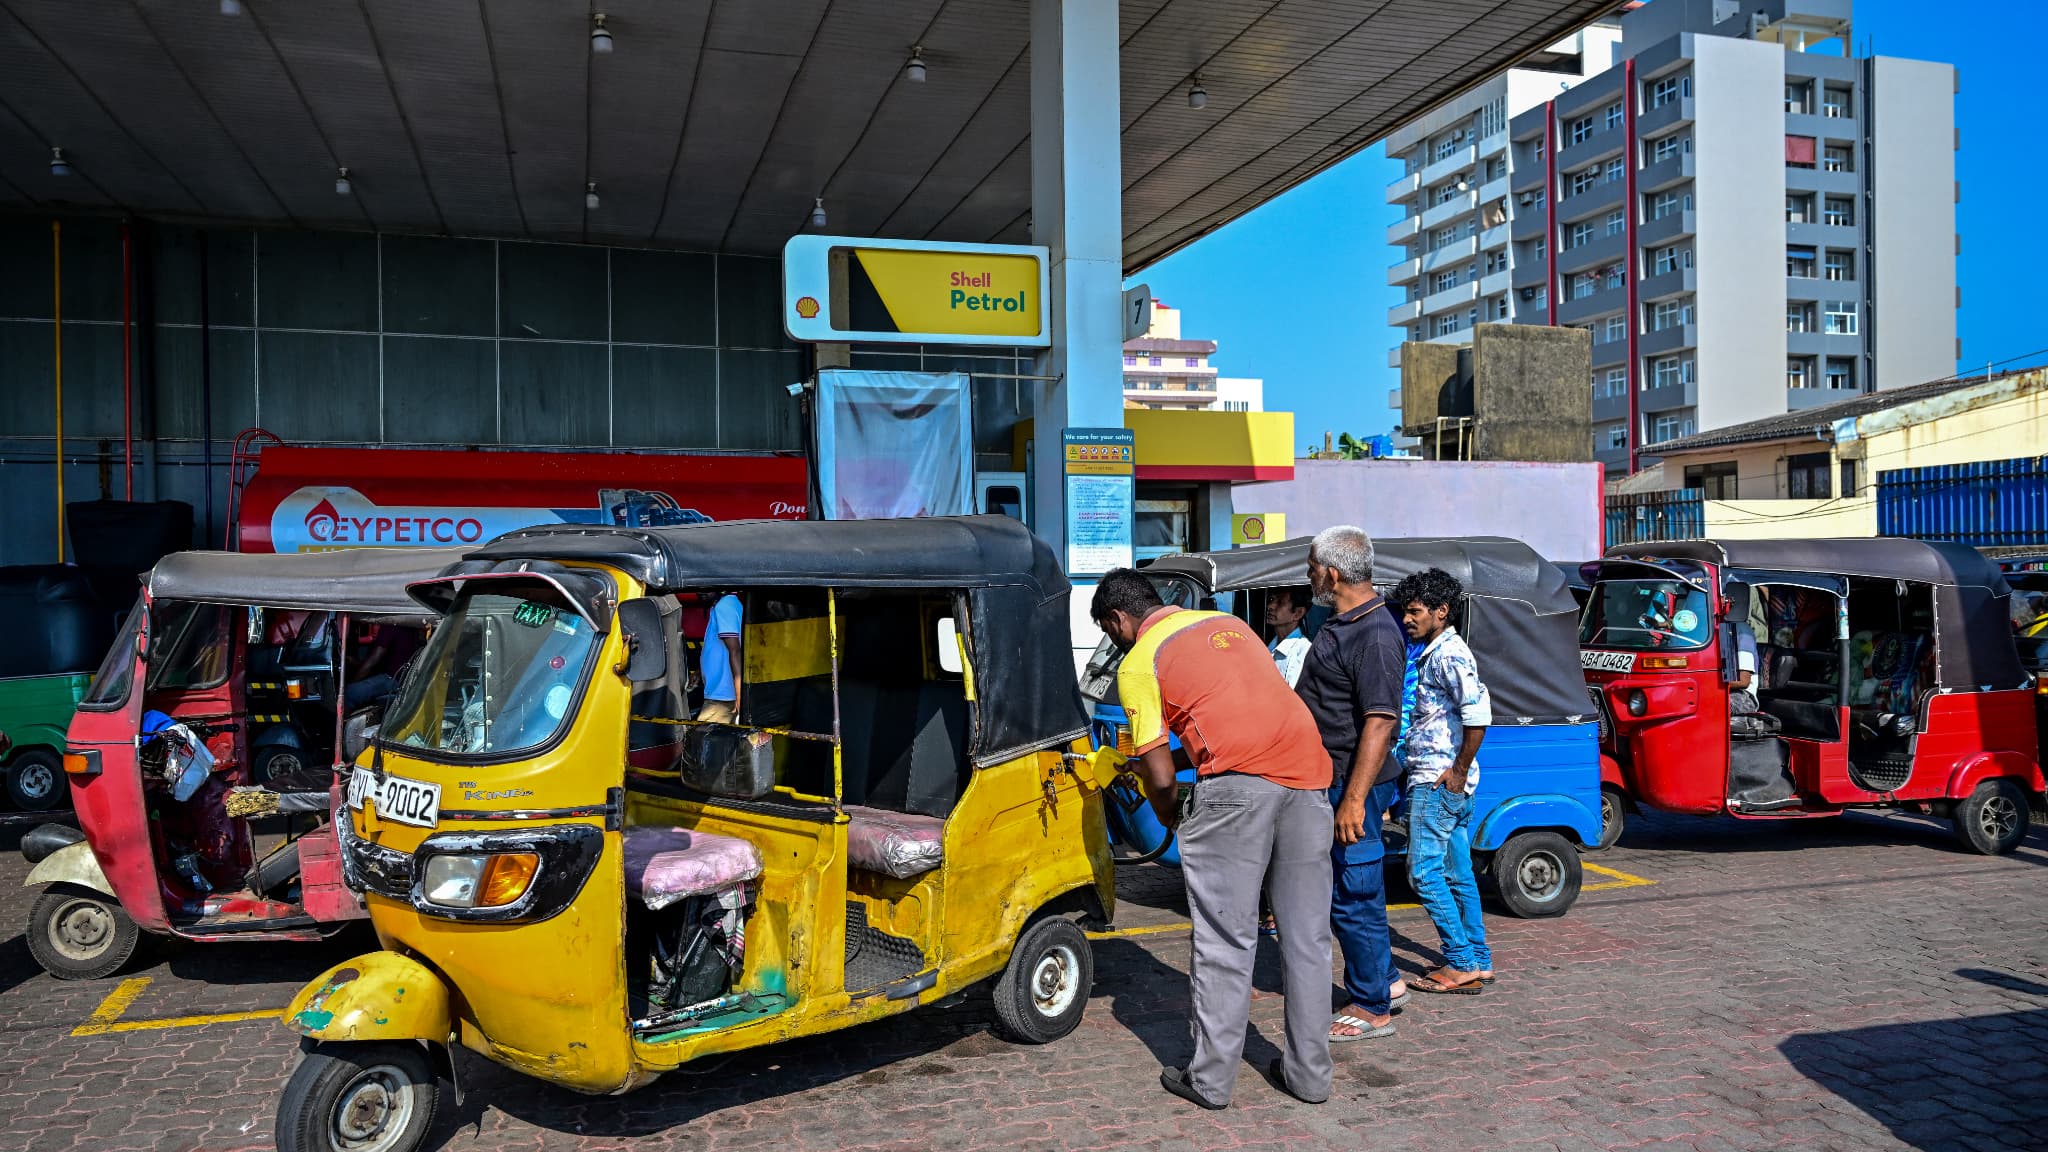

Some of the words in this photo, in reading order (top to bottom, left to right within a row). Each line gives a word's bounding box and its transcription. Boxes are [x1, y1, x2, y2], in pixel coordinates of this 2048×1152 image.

[950, 271, 991, 288] Shell
[950, 289, 1025, 312] Petrol
[1134, 297, 1144, 325] 7
[309, 516, 483, 542] CEYPETCO
[515, 603, 550, 625] TAXI
[1602, 654, 1633, 670] 0482
